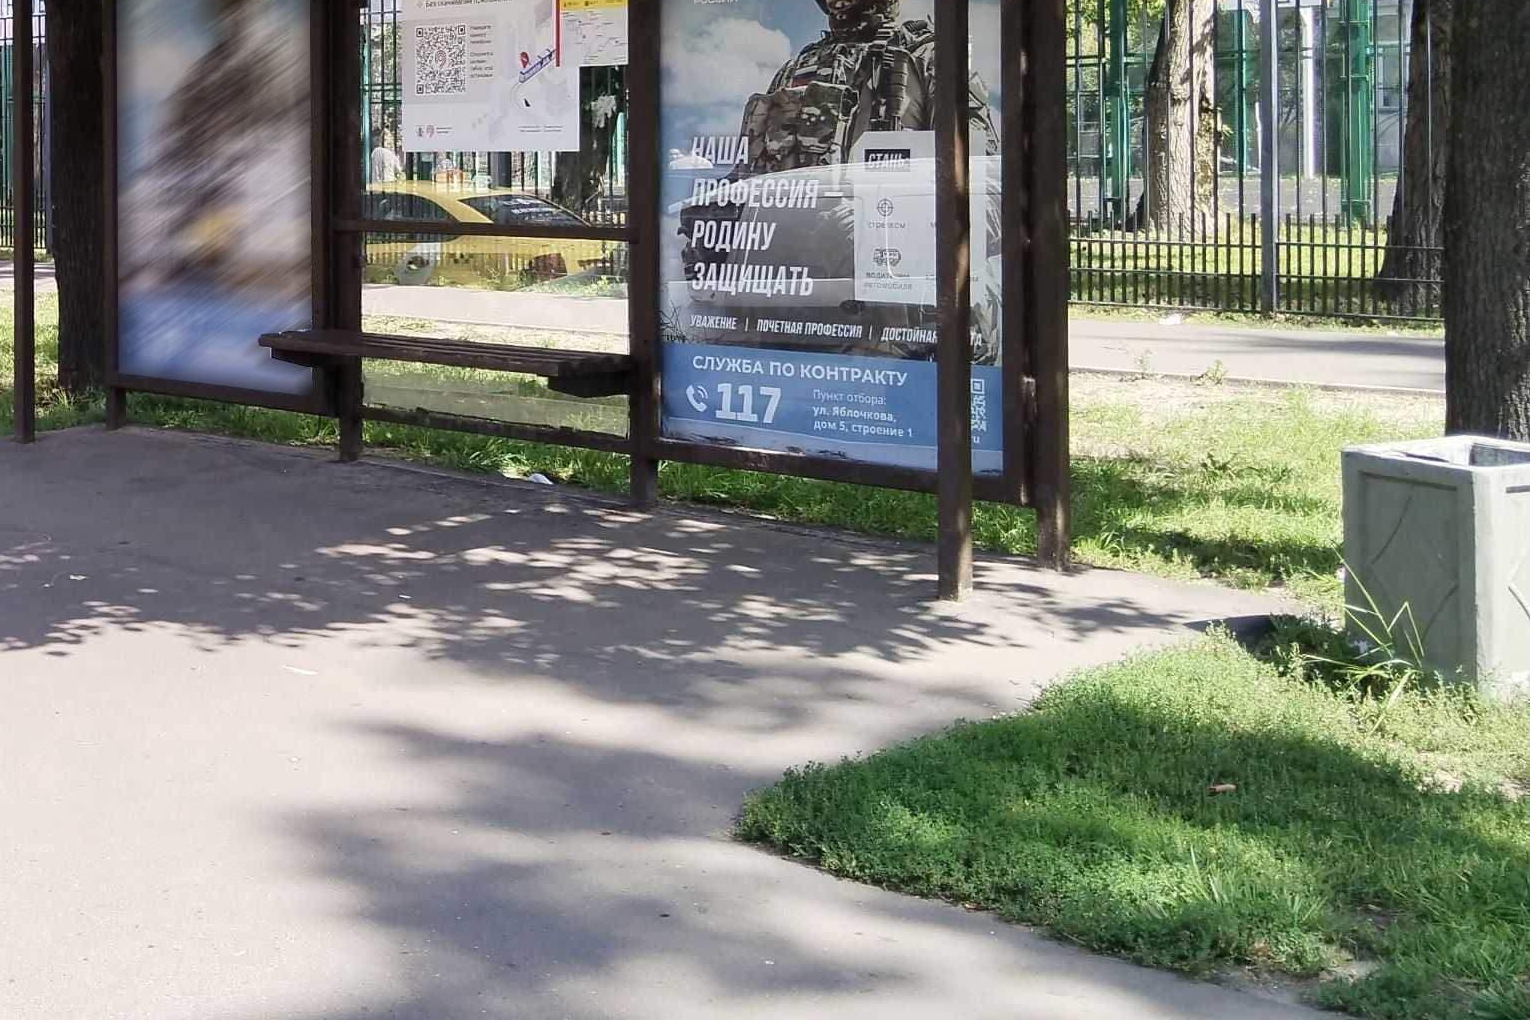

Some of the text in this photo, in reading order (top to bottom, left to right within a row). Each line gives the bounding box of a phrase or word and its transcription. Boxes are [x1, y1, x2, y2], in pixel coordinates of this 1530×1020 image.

[692, 136, 750, 165] НАША
[691, 178, 820, 209] ПРОФЕССИЯ
[691, 220, 777, 252] РОДИНУ
[692, 262, 815, 298] ЗАЩИЩАТЬ
[690, 314, 938, 344] УВАЖЕНИЕ ПОЧЕТНАЯ ПРОФЕССИЯ ДОСТОЙНАЯ
[692, 355, 908, 386] СЛУЖБА ПО КОНТРАКТУ
[715, 382, 782, 424] 117
[813, 389, 887, 406] Пункт отбора:
[812, 406, 897, 423] ул. Яблочкова,
[813, 421, 913, 438] дом 5, строение 1
